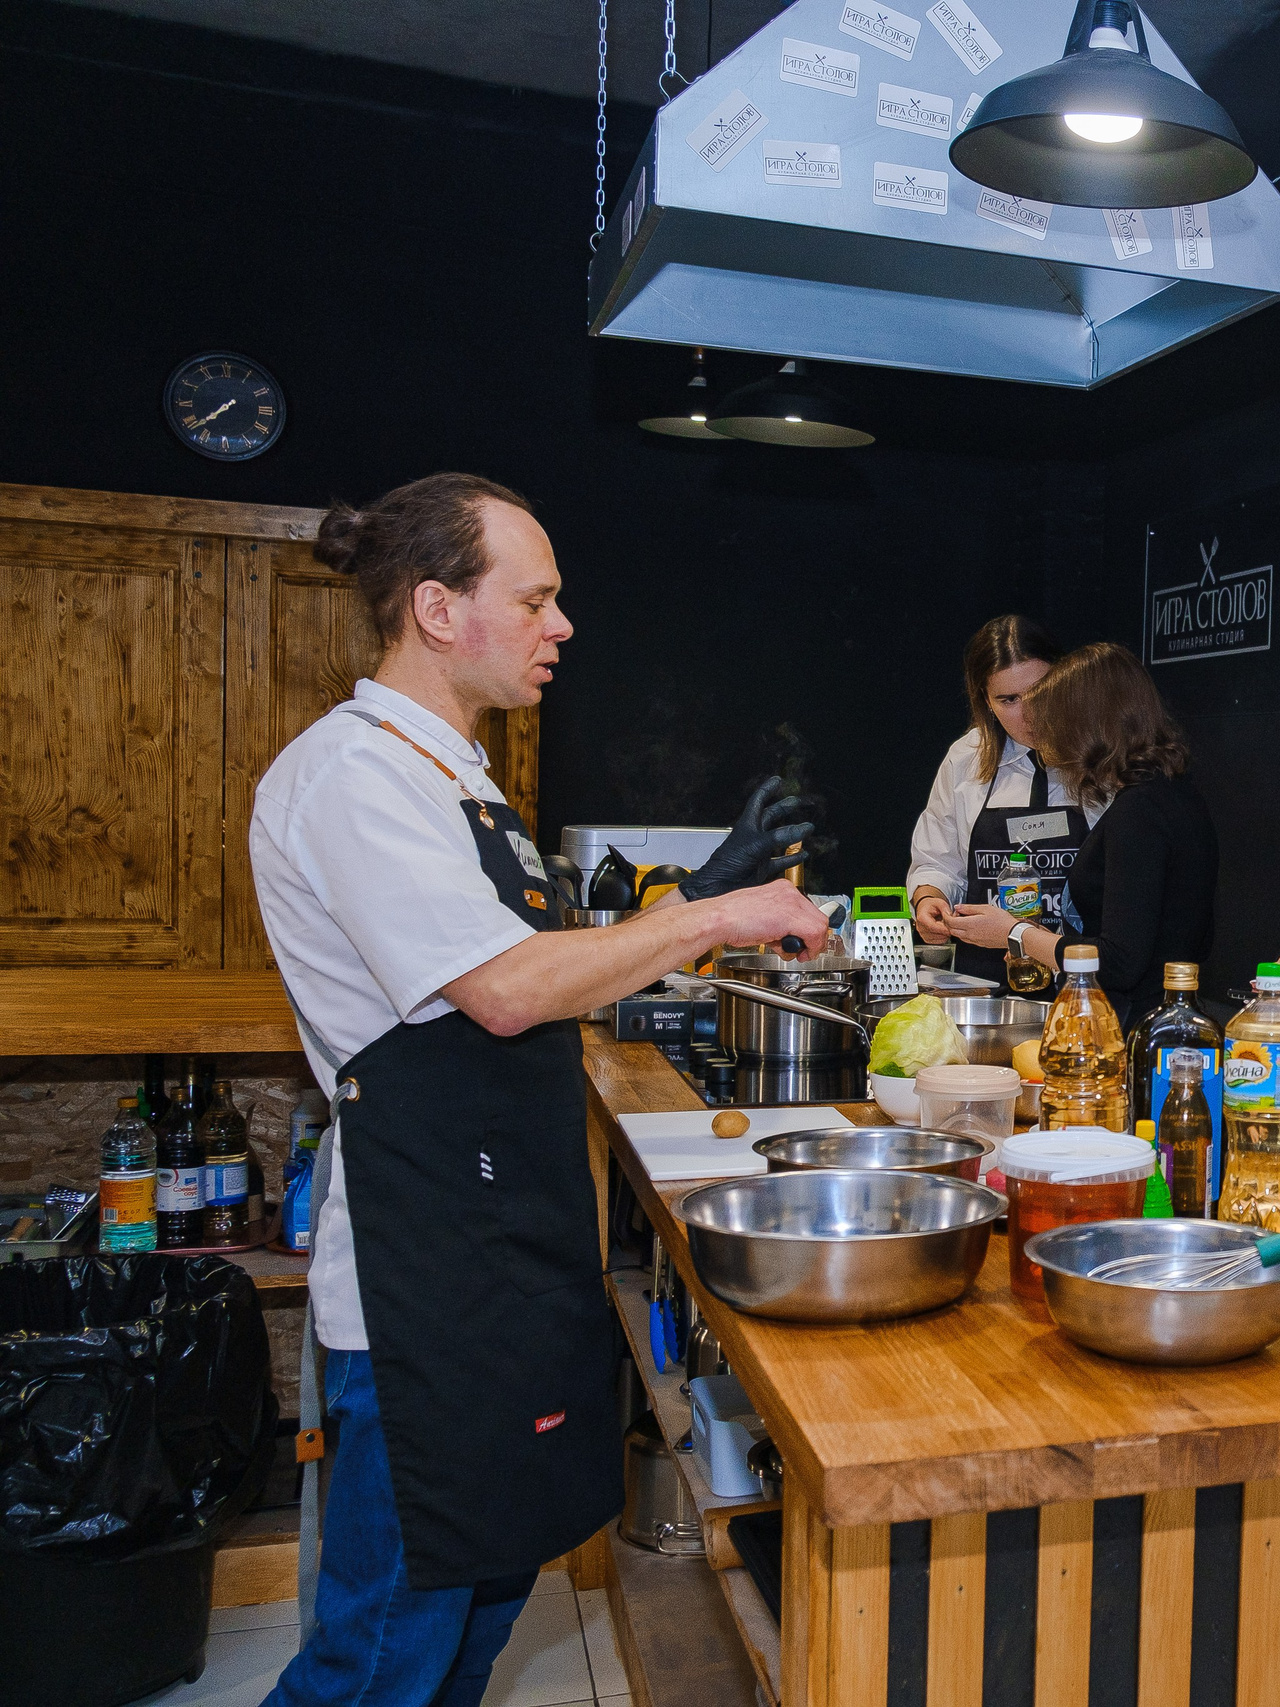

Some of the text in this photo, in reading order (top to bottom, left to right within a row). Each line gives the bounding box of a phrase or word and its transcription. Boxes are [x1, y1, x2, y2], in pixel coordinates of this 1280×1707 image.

[847, 10, 871, 29] ИГРА
[873, 22, 912, 47] СТОЛОВ
[939, 4, 958, 29] ИГРА
[957, 28, 987, 65] СТОЛОВ
[785, 57, 810, 72] ИГРА
[812, 64, 854, 82] СТОЛОВ
[882, 102, 906, 116] ИГРА
[908, 108, 947, 125] СТОЛОВ
[702, 138, 726, 160] ИГРА
[722, 107, 755, 140] СТОЛОВ
[767, 160, 794, 172] ИГРА
[795, 161, 836, 174] СТОЛОВ
[877, 181, 902, 194] ИГРА
[904, 186, 943, 200] СТОЛОВ
[983, 195, 1006, 212] ИГРА
[1007, 204, 1046, 227] СТОЛОВ
[1155, 579, 1266, 635] ИГРА СТОЛОВ
[1168, 629, 1245, 651] КУЛИНАРНАЯ СТУДИЯ
[977, 852, 1078, 869] ИГРА ТОЛО
